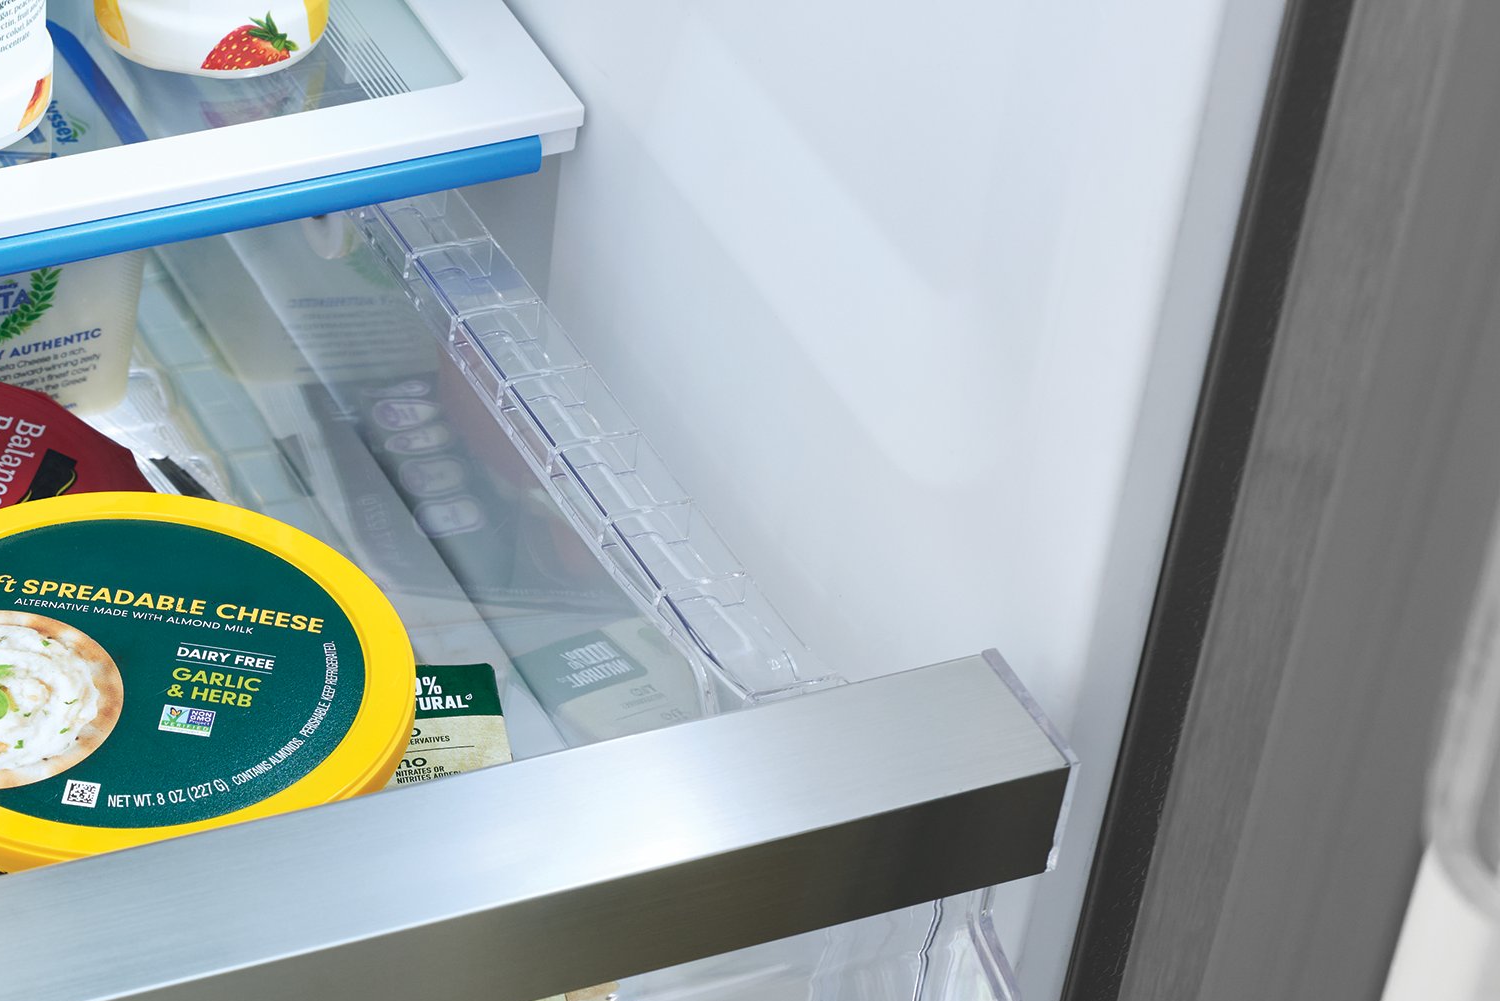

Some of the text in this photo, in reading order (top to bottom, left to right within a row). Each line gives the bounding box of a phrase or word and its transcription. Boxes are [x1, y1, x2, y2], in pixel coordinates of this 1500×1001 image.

[9, 328, 102, 359] AUTHENTIC
[13, 358, 79, 380] award-winning
[16, 352, 52, 369] Cheese
[13, 597, 255, 635] ALTERNATIVE MADE WITH ALMOND MILK
[21, 578, 207, 616] SPREADABLE
[215, 603, 325, 634] CHEESE
[176, 645, 276, 671] DAIRY FREE
[171, 666, 263, 693] GARLIC
[165, 683, 254, 709] & HERB
[189, 715, 212, 723] GMO
[191, 709, 214, 718] NON
[231, 640, 339, 787] CONTAINS ALMONDS. PERISHABLE. KEEP REFRIGERATED.
[162, 720, 211, 733] VERIFIED
[395, 765, 445, 778] NITRATES OR
[397, 757, 428, 770] no
[396, 773, 432, 785] NITRITES
[107, 777, 231, 809] NET WT. 8 OZ (227 G)
